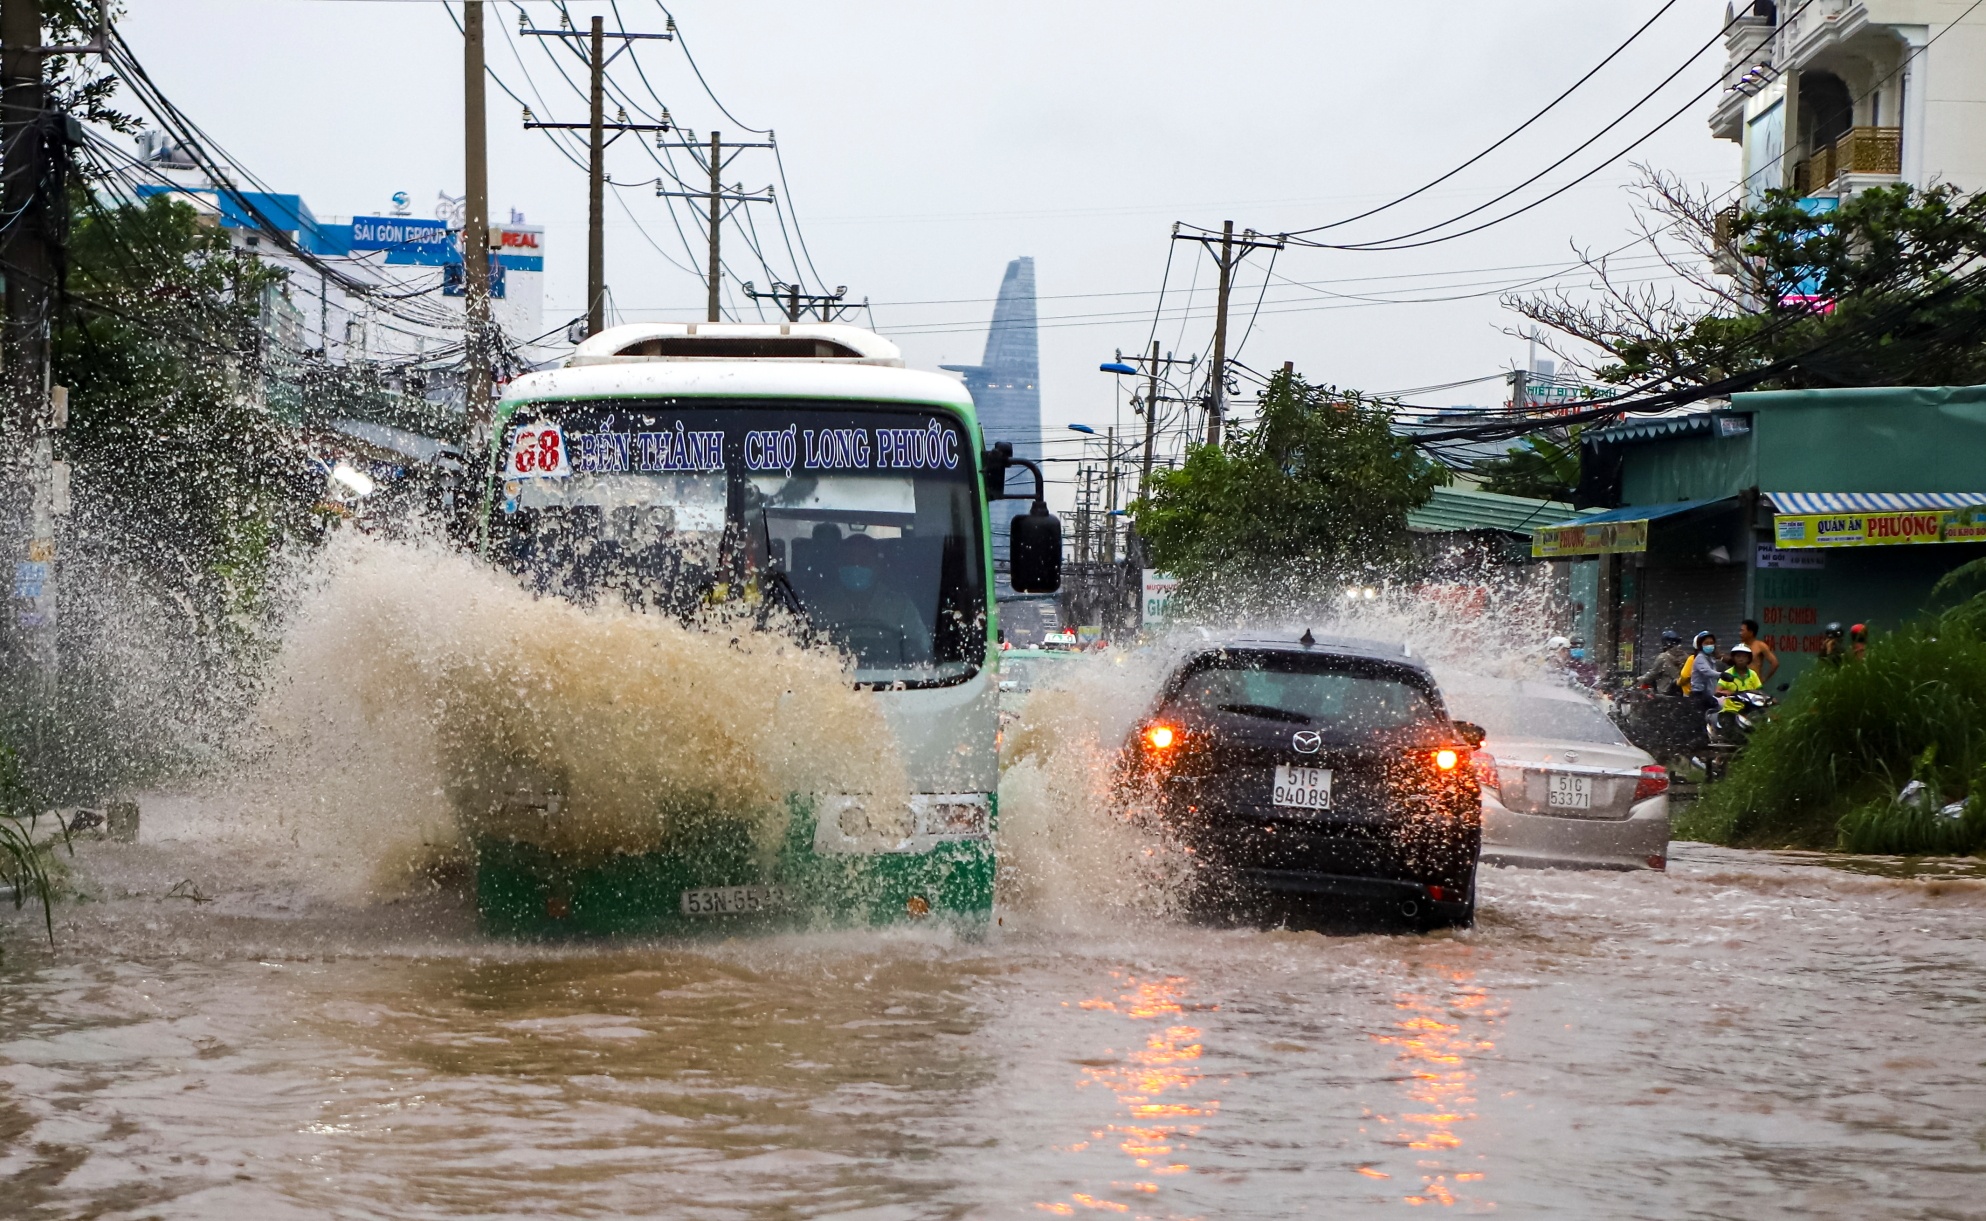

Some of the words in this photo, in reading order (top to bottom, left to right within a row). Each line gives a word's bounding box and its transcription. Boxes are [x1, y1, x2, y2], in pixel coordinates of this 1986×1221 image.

[405, 226, 446, 245] GROUP
[501, 231, 539, 248] REAL
[580, 414, 631, 472] BẾN
[638, 420, 725, 471] THÀNH
[744, 423, 797, 478] CHỢ
[804, 428, 871, 469] LONG
[876, 417, 959, 470] PHƯỚC
[1817, 516, 1845, 534] QUÁN
[1848, 515, 1862, 531] ĂN
[1867, 513, 1938, 542] PHƯỢNG
[1288, 768, 1318, 787] 51G
[1560, 777, 1582, 791] 51G
[1275, 786, 1328, 807] 940.89
